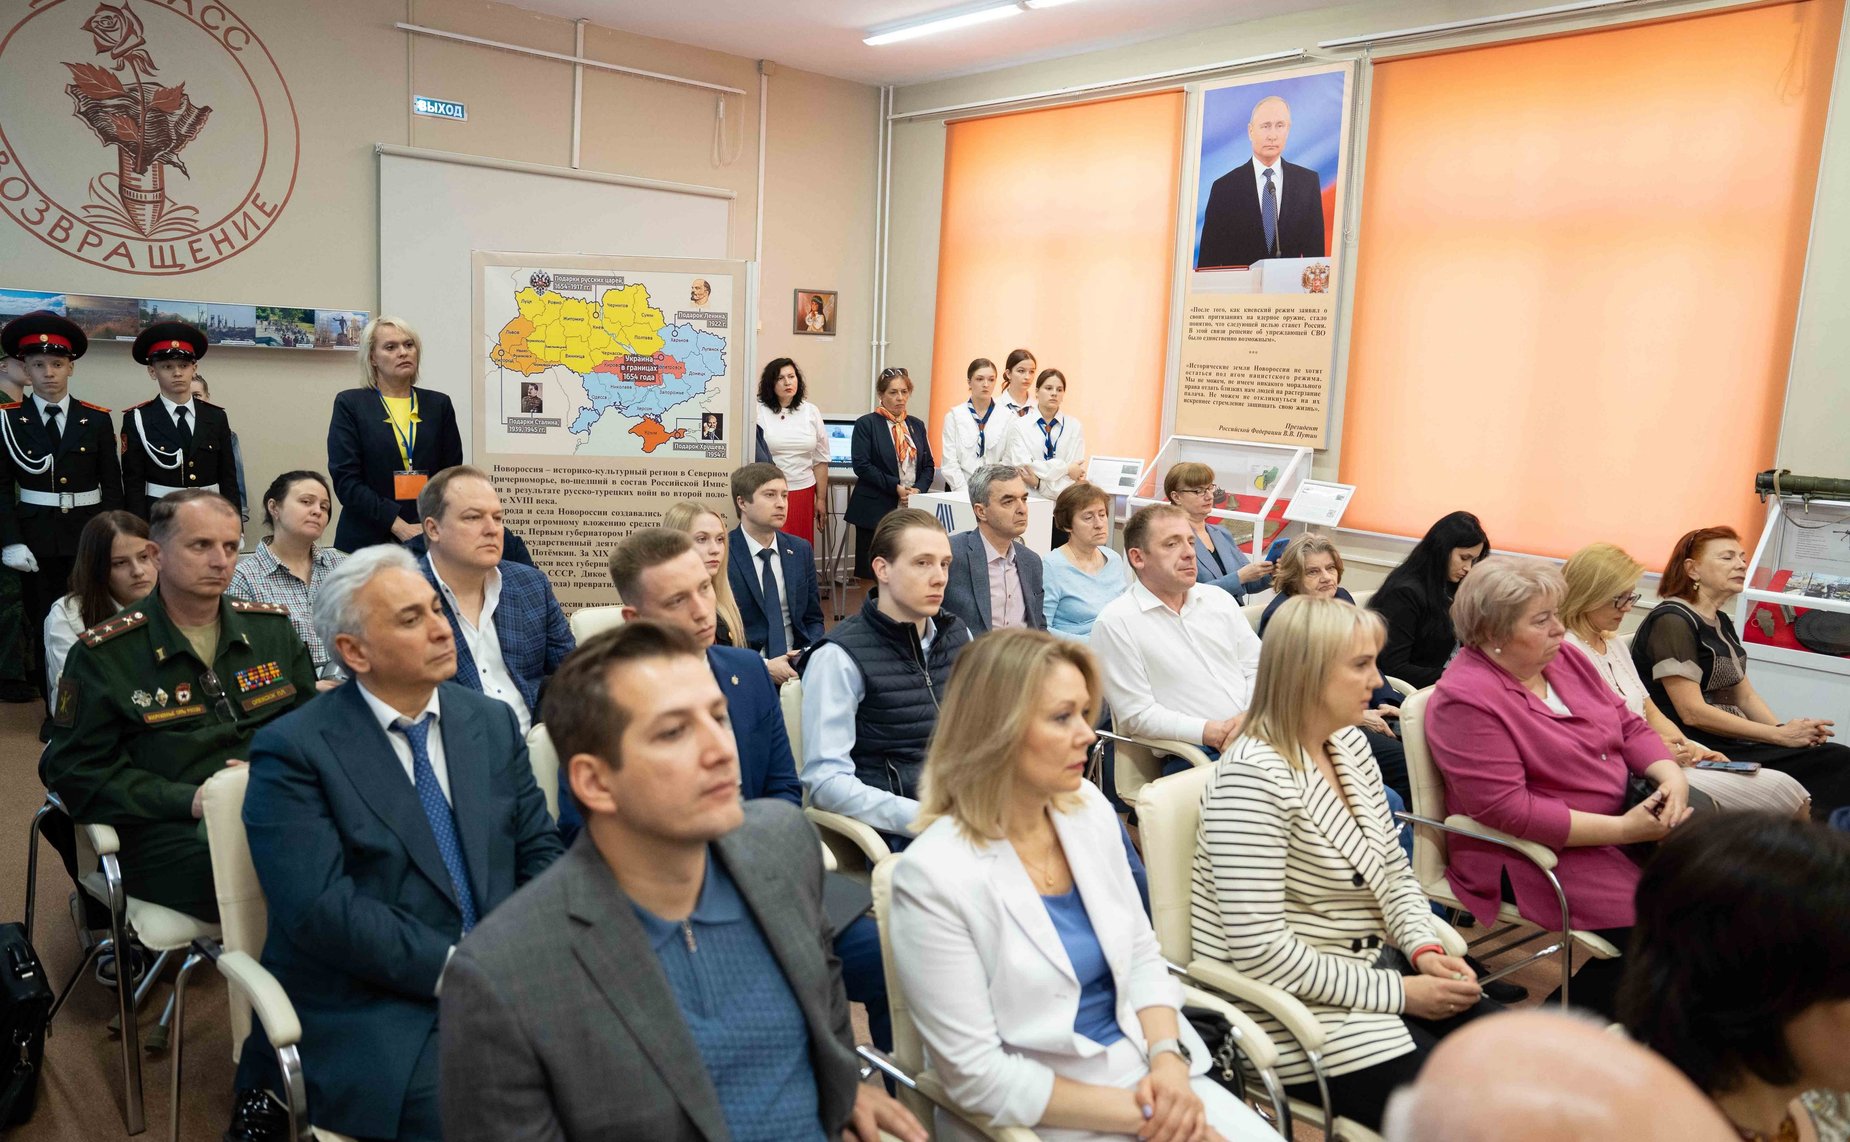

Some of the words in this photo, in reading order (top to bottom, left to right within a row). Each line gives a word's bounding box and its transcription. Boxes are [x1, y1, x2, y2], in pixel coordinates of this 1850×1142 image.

[418, 100, 462, 117] ВЫХОД
[554, 276, 579, 284] Подарки
[1285, 422, 1318, 432] Президент
[493, 465, 544, 475] Новороссия
[553, 466, 647, 478] историко-культурный
[649, 471, 678, 479] регион
[687, 470, 728, 480] Северном
[560, 477, 608, 487] во-шедший
[651, 479, 699, 487] Российской
[514, 488, 561, 497] результате
[564, 489, 634, 498] русско-турецких
[673, 490, 702, 500] второй
[509, 496, 534, 504] XVIII
[558, 508, 608, 518] Новороссии
[611, 511, 662, 519] создавались
[533, 520, 579, 528] огромному
[629, 522, 661, 530] средств
[528, 528, 564, 538] Первым
[565, 529, 623, 538] губернатором
[548, 570, 576, 579] СССР,
[580, 570, 607, 580] Дикое
